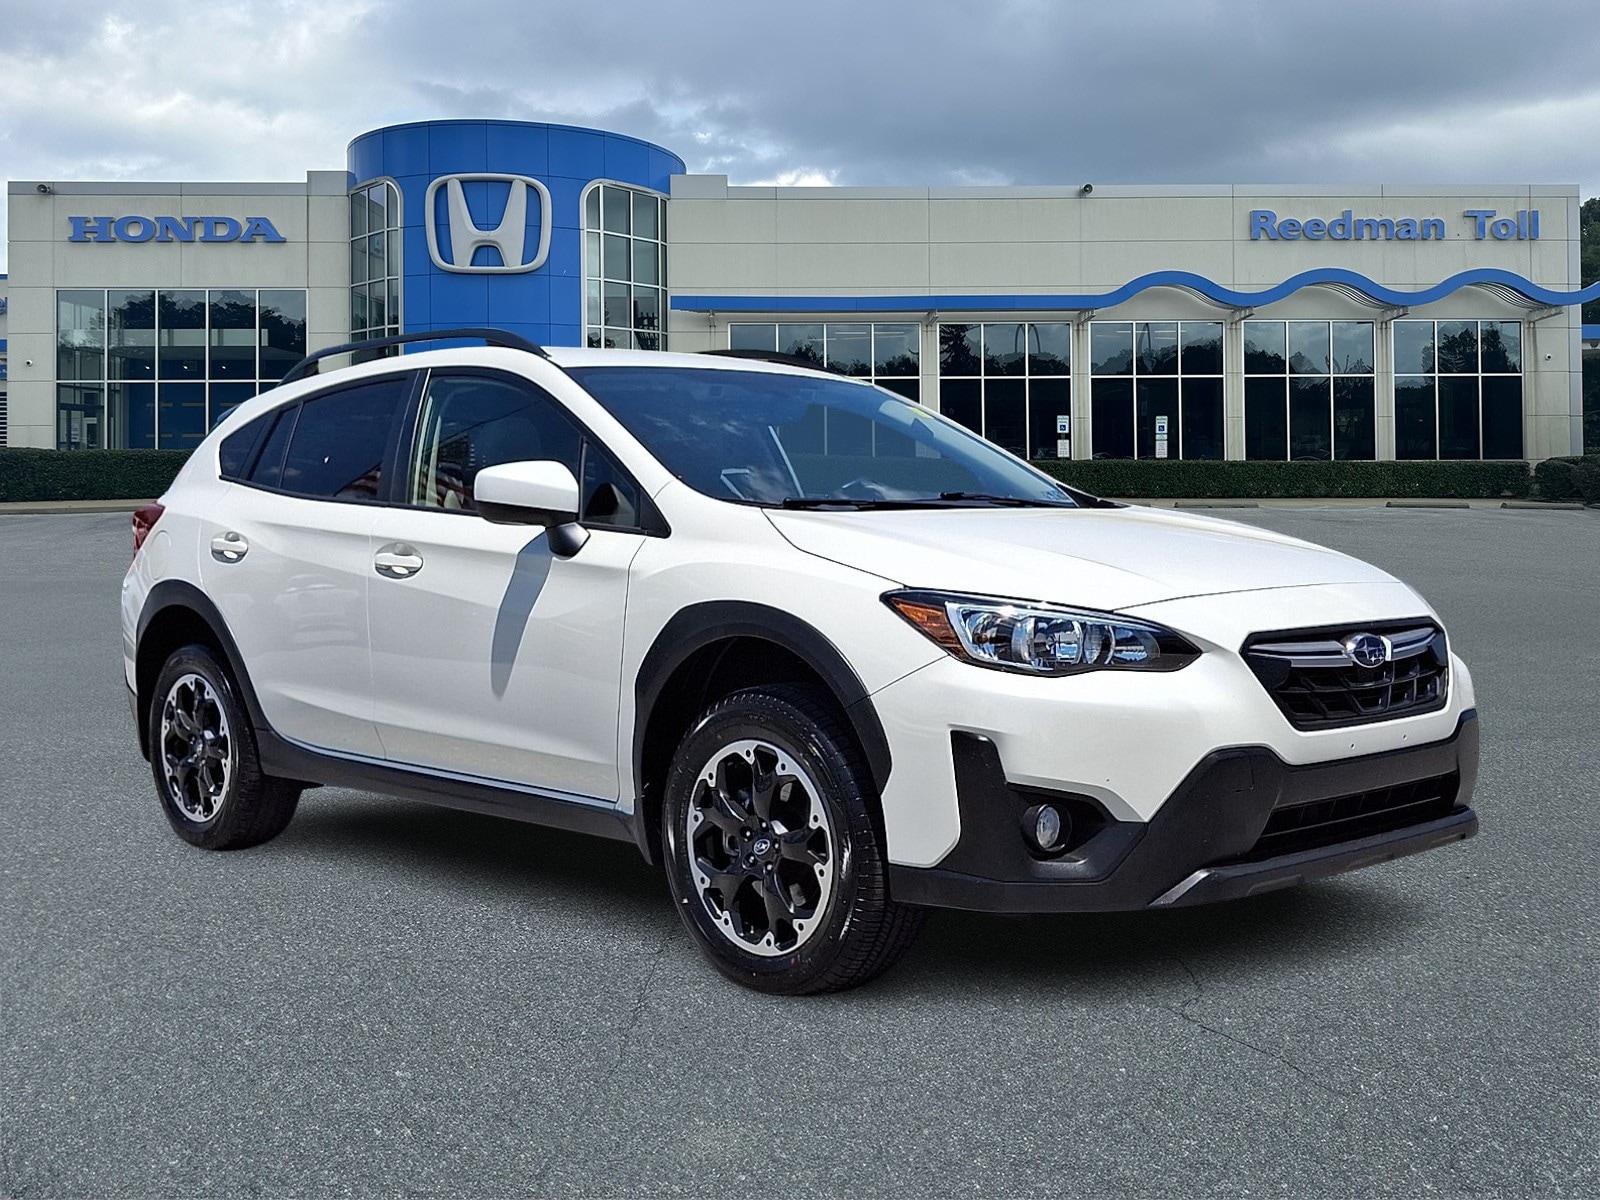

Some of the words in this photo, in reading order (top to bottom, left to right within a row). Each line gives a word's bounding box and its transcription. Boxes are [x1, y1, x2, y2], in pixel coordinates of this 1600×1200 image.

[67, 215, 287, 243] HONDA
[1250, 209, 1446, 240] Reedman
[1464, 209, 1539, 240] Toll
